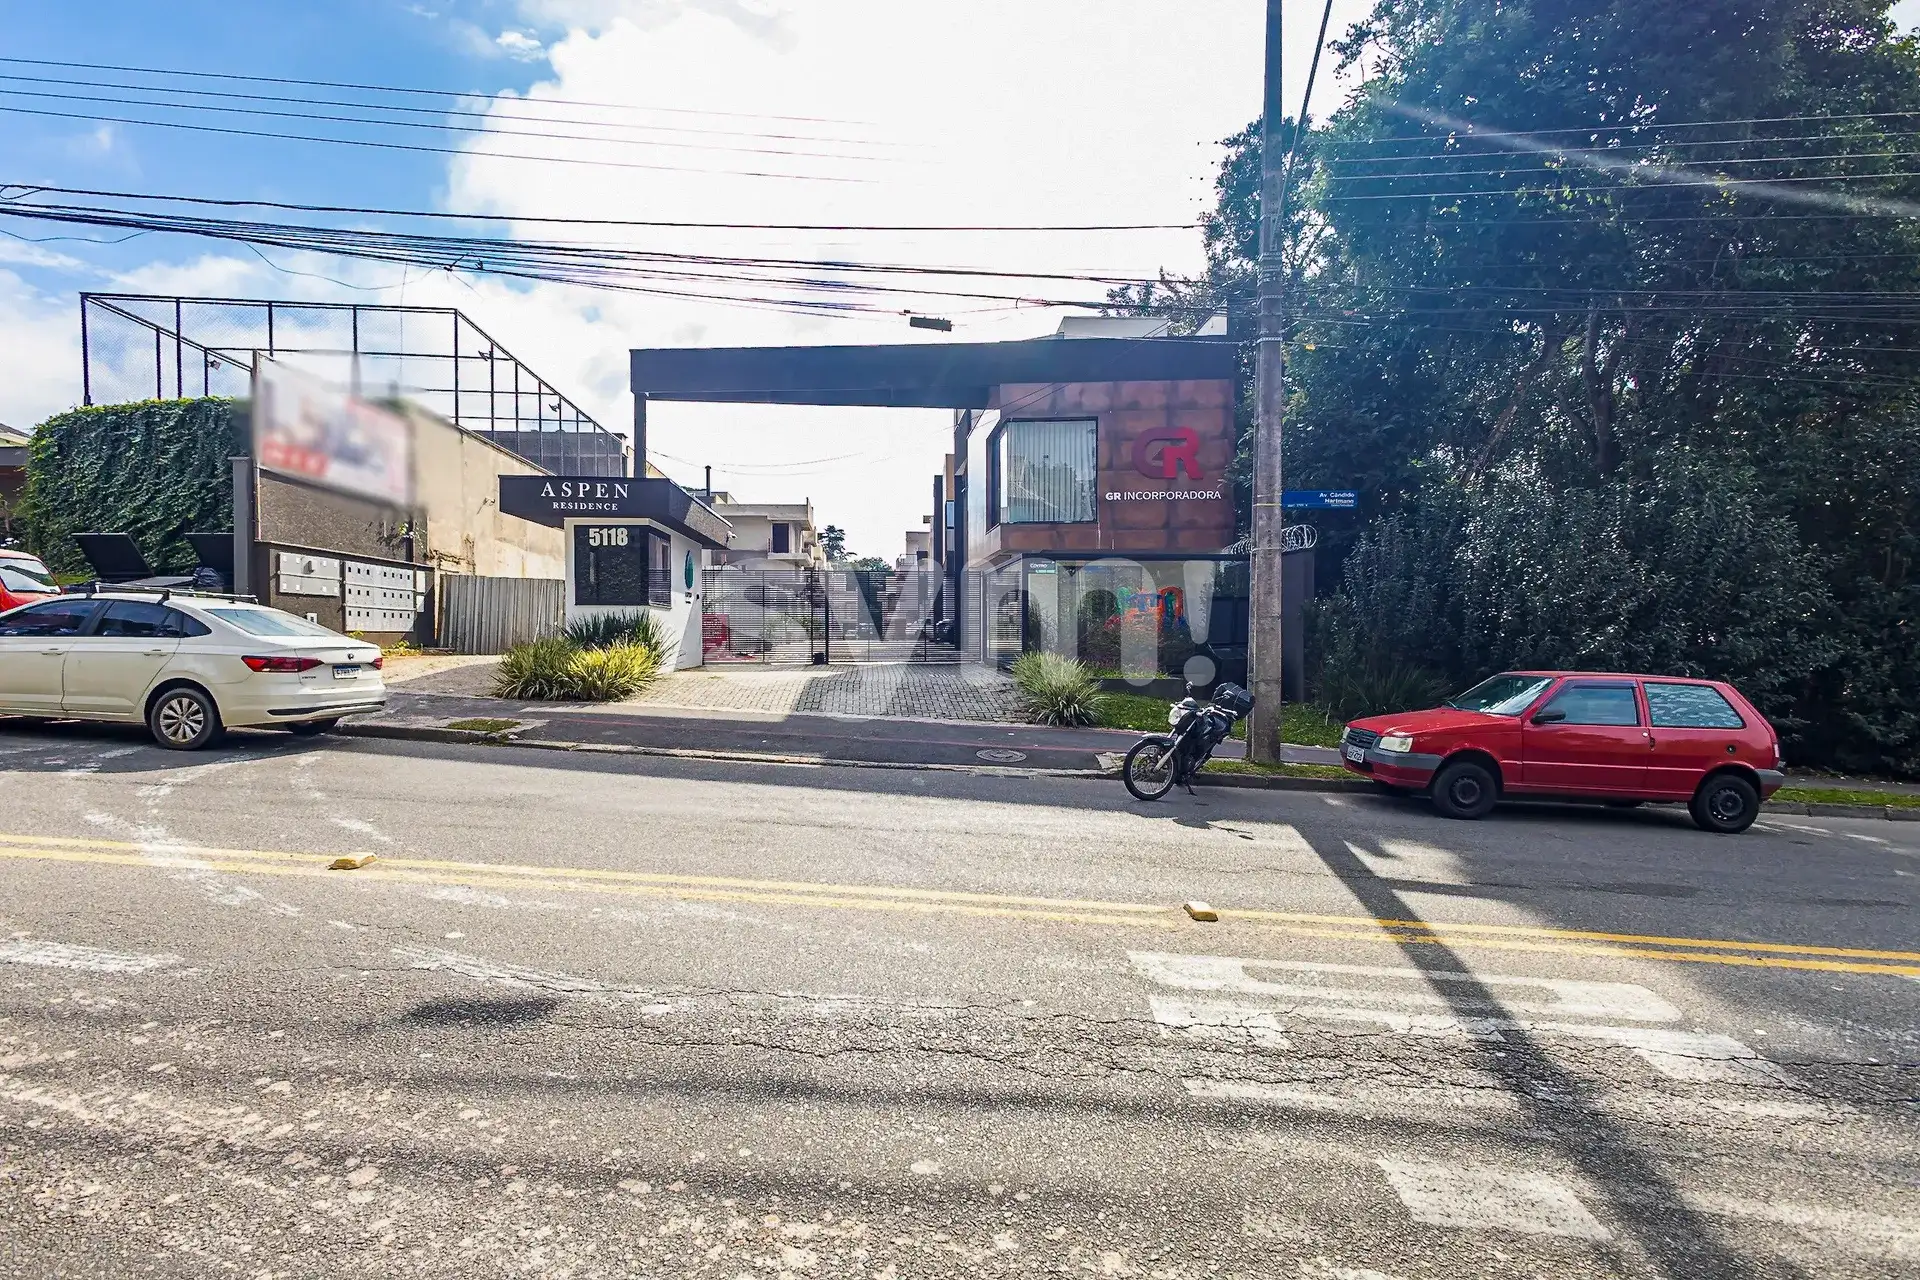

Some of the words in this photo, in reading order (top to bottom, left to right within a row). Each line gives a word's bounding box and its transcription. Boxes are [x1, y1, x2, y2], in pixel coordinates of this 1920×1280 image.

[540, 482, 629, 498] ASPEN
[1105, 492, 1122, 501] GR
[1124, 490, 1222, 500] INCORPORADORA
[552, 501, 618, 511] RESIDENCE
[588, 527, 629, 547] 5118
